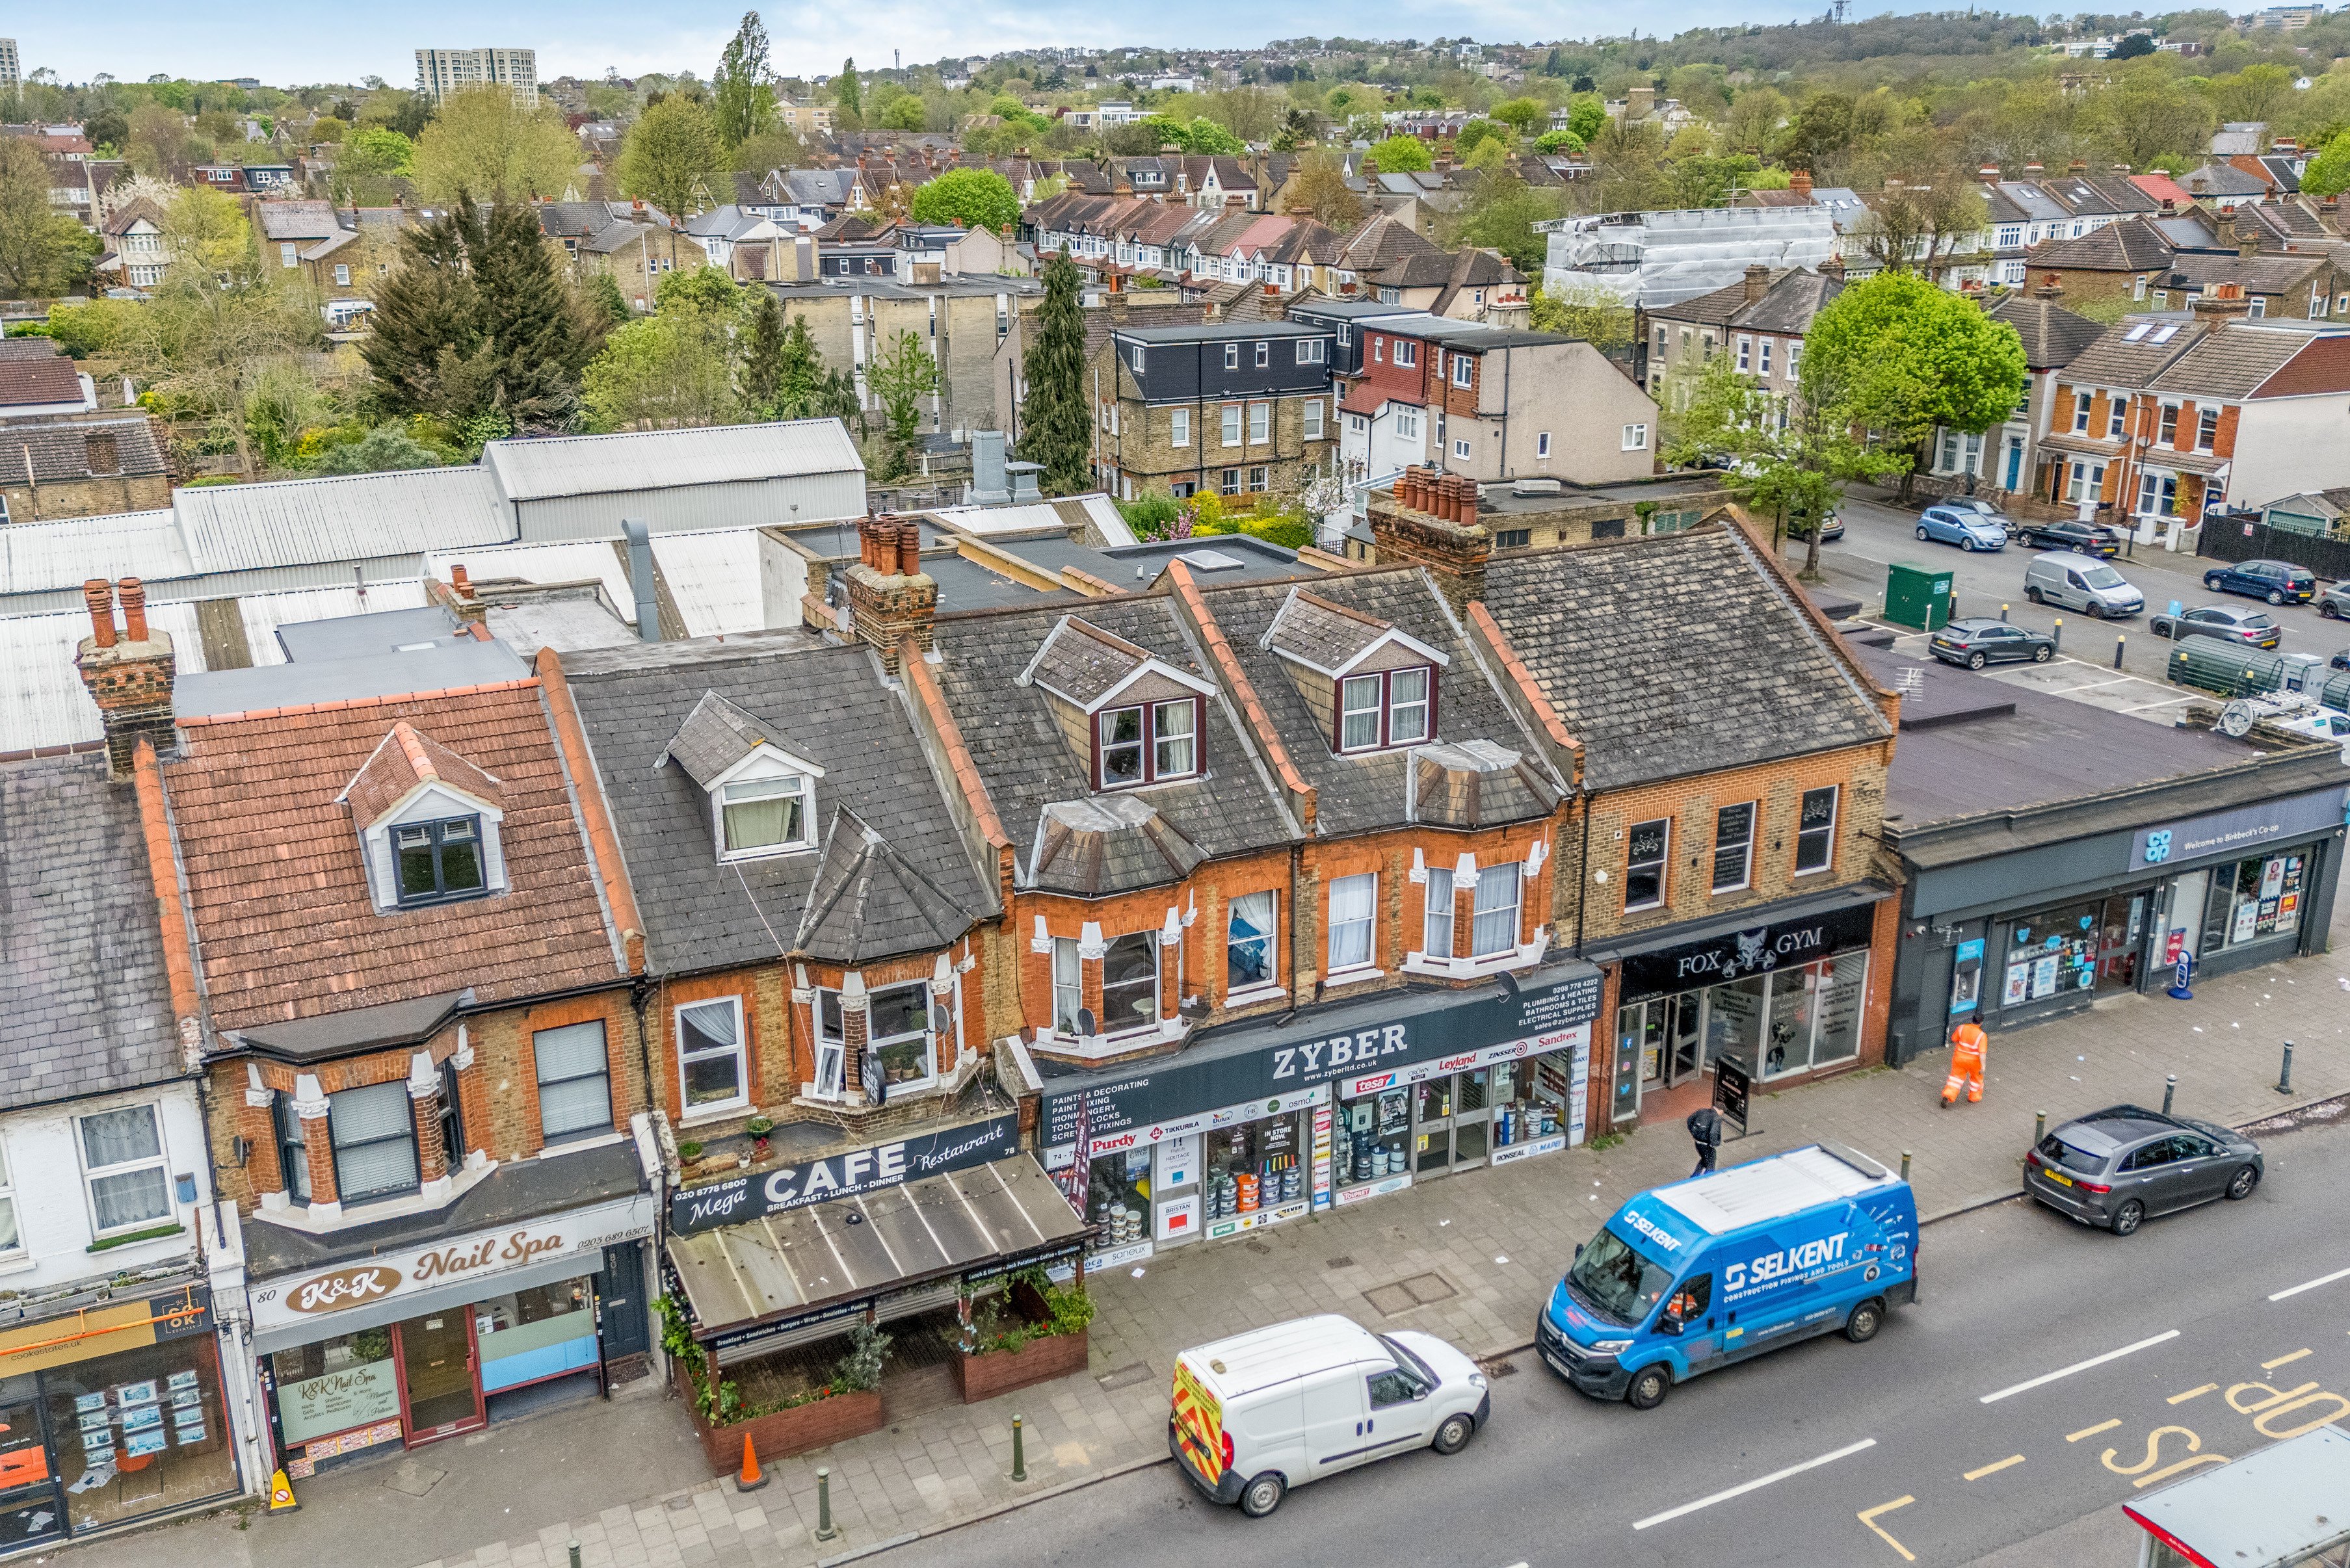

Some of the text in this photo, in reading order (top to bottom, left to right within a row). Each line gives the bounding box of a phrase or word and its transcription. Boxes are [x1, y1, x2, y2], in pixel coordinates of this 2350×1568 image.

[2185, 839, 2215, 850] Welcome
[2225, 828, 2257, 841] Birkbeck's
[2258, 824, 2279, 835] Co-op
[1678, 950, 1722, 977] FOX
[1776, 927, 1823, 954] GYM
[1523, 995, 1559, 1009] PLUMBING
[1567, 987, 1598, 999] HEATING
[1553, 986, 1568, 994] 0208
[1518, 1002, 1596, 1026] ELECTRICAL SUPPLIES
[1525, 1001, 1569, 1017] BATHROOMS
[1578, 995, 1596, 1004] TILES
[1534, 1012, 1596, 1030] sales@zyber.co.uk
[1538, 1032, 1577, 1047] Sandtex
[1273, 1024, 1408, 1080] ZYBER
[1439, 1052, 1477, 1071] Leyland
[1488, 1048, 1516, 1059] ZINSSER
[1304, 1060, 1377, 1082] www.zyberltd.co.uk
[1408, 1067, 1429, 1077] CROWN
[863, 1077, 878, 1103] OPEN
[1052, 1093, 1082, 1106] PAINTS
[1094, 1079, 1149, 1097] DECORATING
[1358, 1078, 1384, 1091] tesa
[1052, 1097, 1110, 1115] PAINT IXING
[1288, 1097, 1310, 1108] osmo
[1052, 1104, 1116, 1123] IRONMNGERY
[1091, 1112, 1120, 1124] LOCKS
[1213, 1116, 1231, 1124] Dulux
[1098, 1117, 1132, 1130] FIXINGS
[1165, 1121, 1200, 1134] TIKKURILA
[1273, 1126, 1292, 1136] STORE
[921, 1124, 1004, 1171] Restaurant
[1004, 1146, 1015, 1156] 78
[1092, 1134, 1137, 1153] Purdy
[1540, 1140, 1562, 1151] MAPEI
[1166, 1152, 1191, 1161] HERITAGE
[1496, 1149, 1525, 1162] RONSEAL
[765, 1142, 906, 1203] CAFE
[675, 1178, 747, 1201] 020 8778 6800
[767, 1194, 823, 1213] BREAKFAST
[830, 1183, 862, 1197] LUNCH
[869, 1174, 904, 1188] DINNER
[1343, 1188, 1370, 1200] TOUPRET
[689, 1188, 748, 1226] Mega
[577, 1225, 650, 1249] 0203 689 6507
[1633, 1217, 1682, 1252] SELKENT
[413, 1231, 564, 1281] Nail Spa
[1085, 1259, 1103, 1267] oca
[1112, 1246, 1146, 1261] saneux
[1749, 1231, 1848, 1284] SELKENT
[968, 1272, 983, 1281] Lunch
[1017, 1257, 1037, 1267] Potatoes
[1040, 1252, 1055, 1261] Coffee
[1057, 1246, 1080, 1256] Smoothies
[301, 1269, 386, 1309] K&K
[1723, 1259, 1849, 1303] CONSTRUCTION FIXINGS AND TOOLS
[257, 1289, 276, 1304] 80
[170, 1312, 196, 1328] OK
[717, 1335, 742, 1347] Breakfast
[746, 1326, 776, 1339] Sandwiches
[781, 1320, 800, 1330] Burgers
[803, 1314, 820, 1324] Wraps
[823, 1308, 847, 1318] Omelettes
[10, 1339, 82, 1361] cookestates.uk
[298, 1368, 376, 1401] K&K Nail Spa
[326, 1398, 352, 1409] Manicures
[326, 1404, 352, 1415] Pedicures
[304, 1412, 324, 1421] Acrylics
